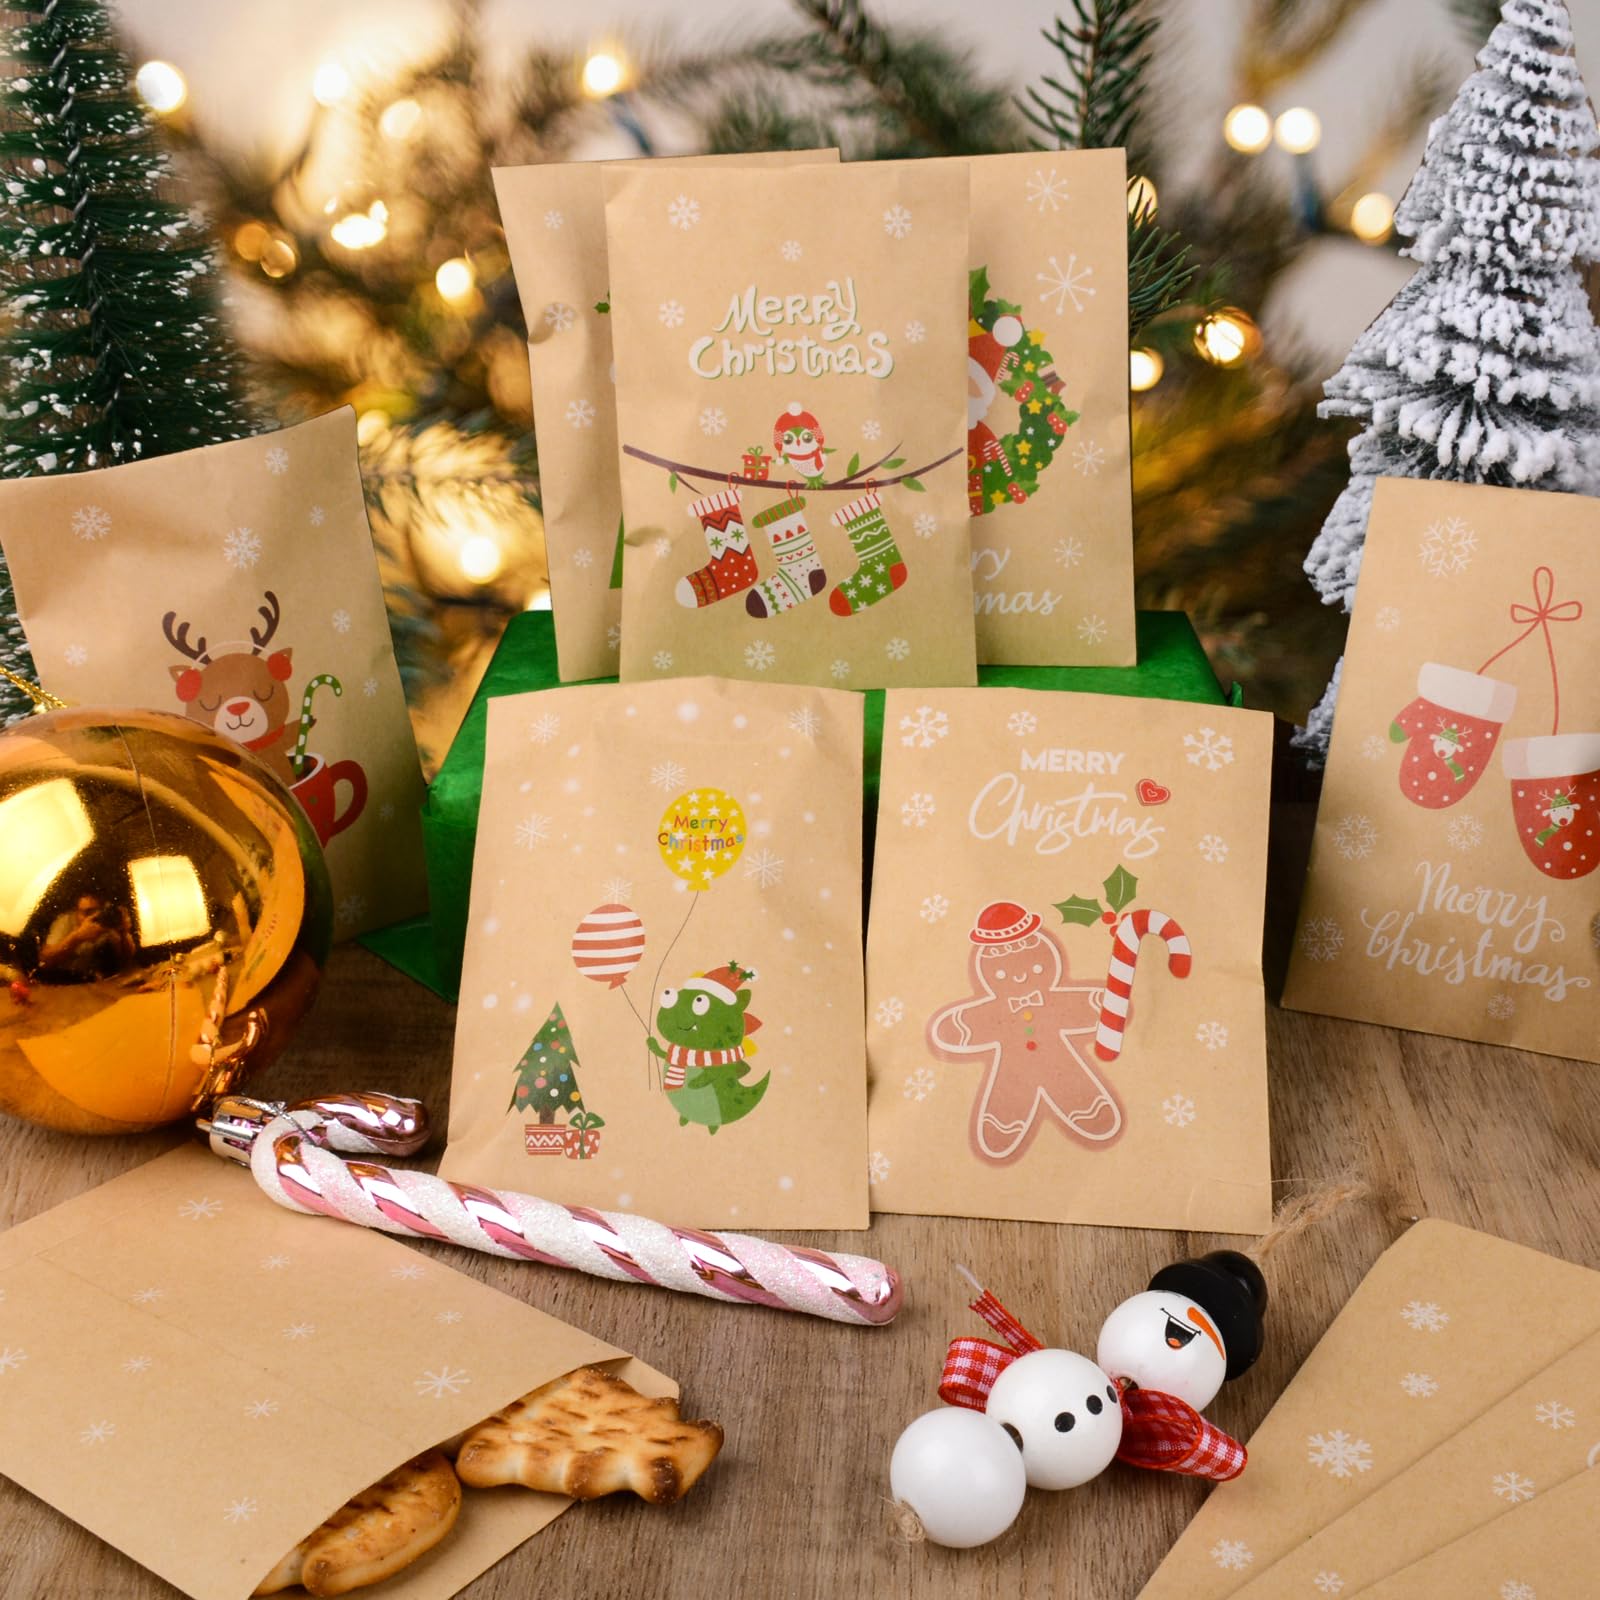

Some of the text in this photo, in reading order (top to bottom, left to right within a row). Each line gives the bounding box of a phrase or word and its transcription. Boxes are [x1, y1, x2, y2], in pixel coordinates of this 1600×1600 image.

[1020, 749, 1125, 774] MERRY
[673, 815, 728, 832] Merry
[968, 771, 1166, 860] Christmas
[1415, 860, 1565, 953] Merry
[1361, 908, 1591, 1002] Christmas
